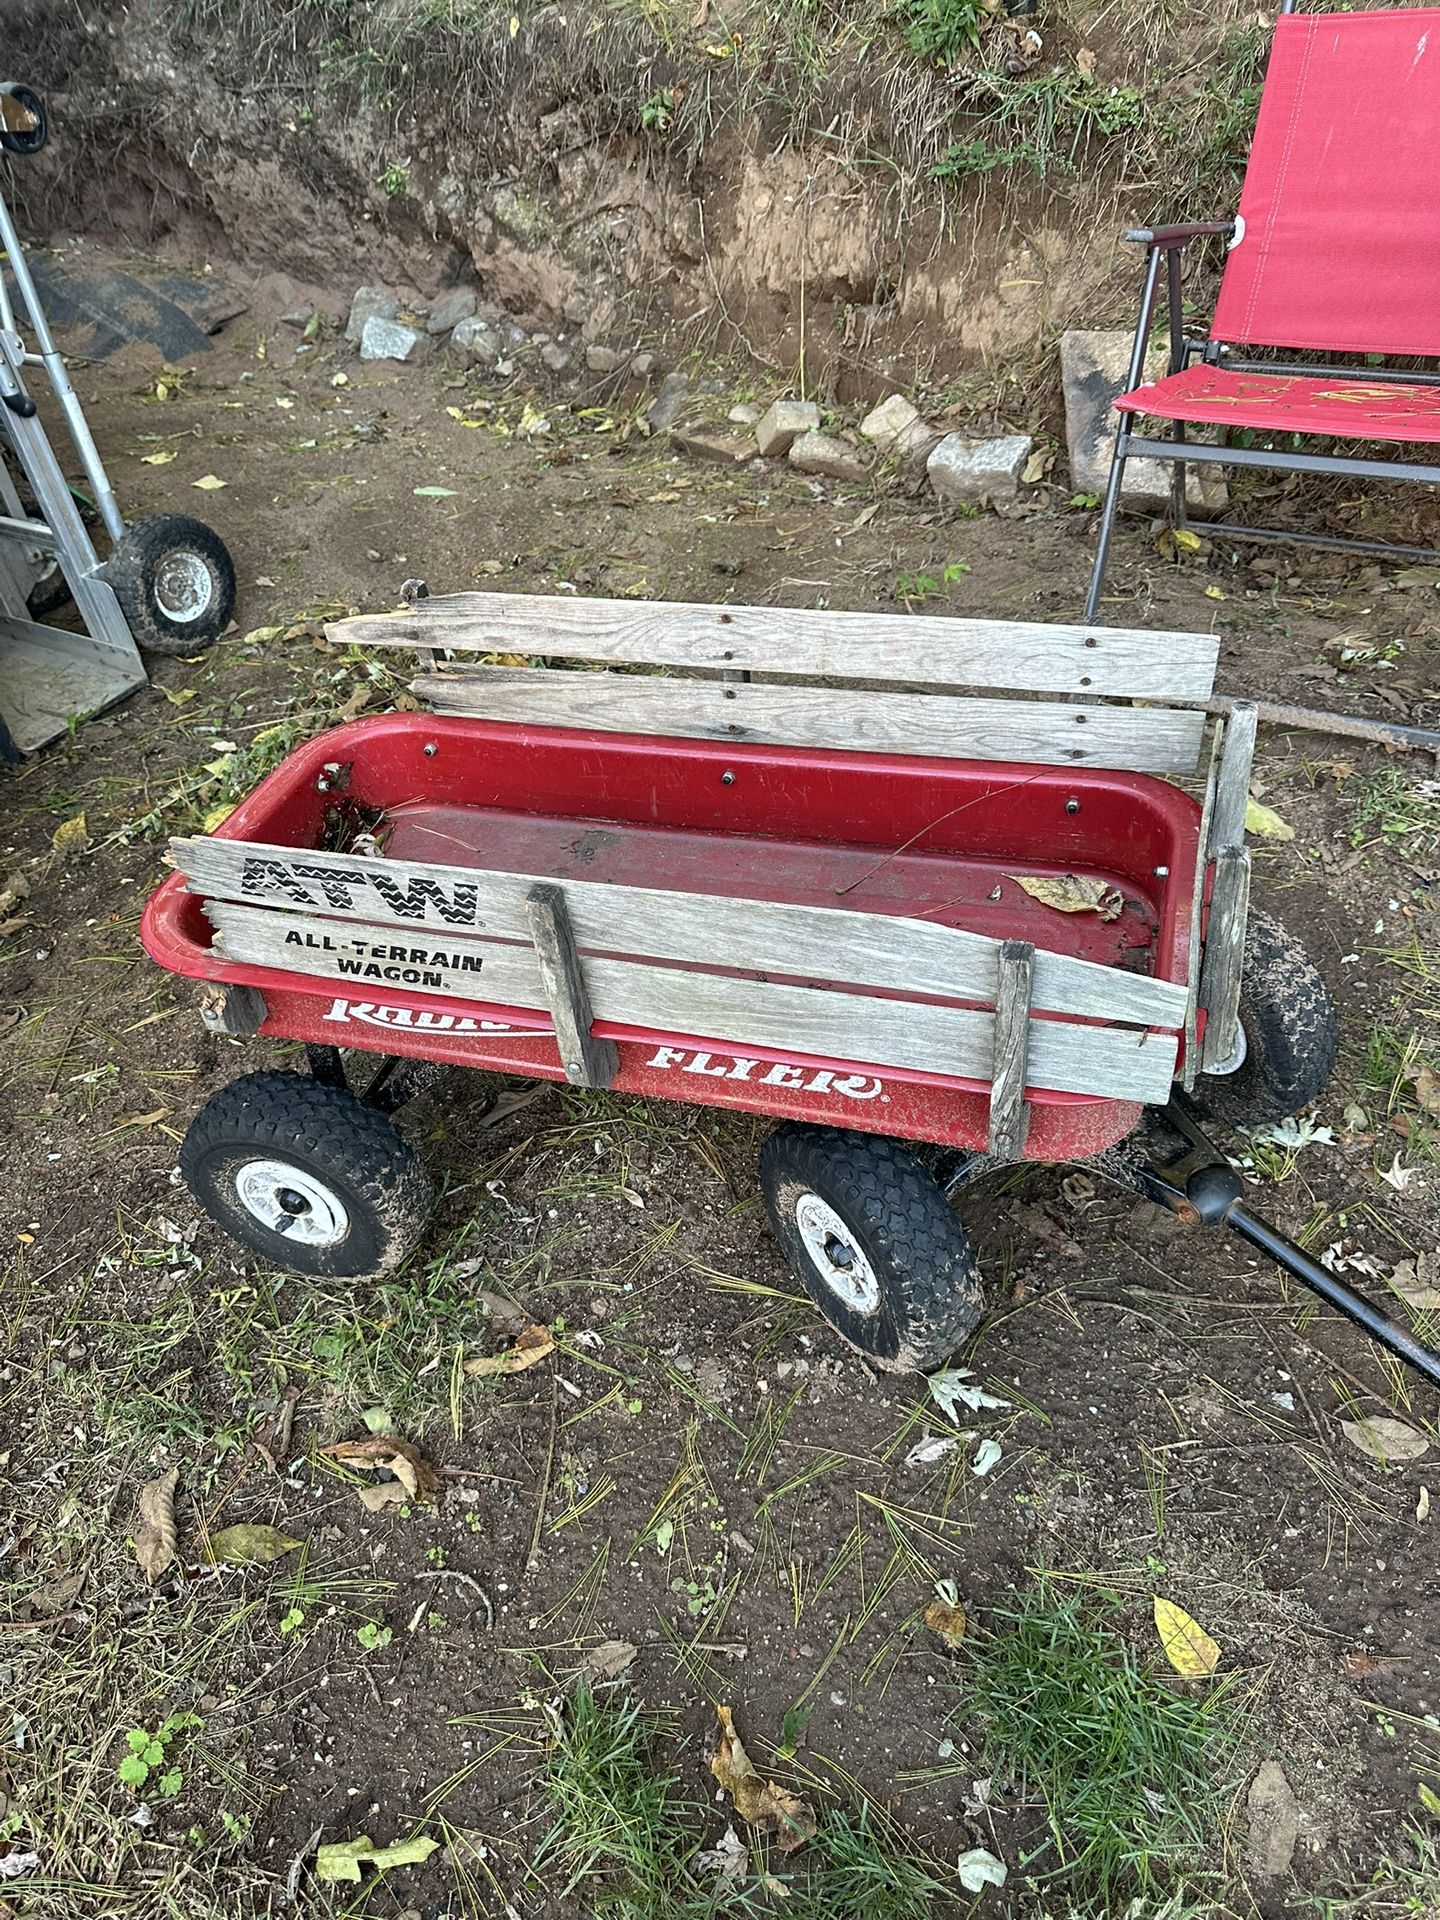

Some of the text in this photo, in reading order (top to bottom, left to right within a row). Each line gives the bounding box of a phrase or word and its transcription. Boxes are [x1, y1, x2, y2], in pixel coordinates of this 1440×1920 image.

[241, 857, 479, 926] ATW
[284, 930, 484, 973] ALL-TERRAIN
[337, 957, 444, 988] WAGON
[645, 1046, 883, 1100] FLYER
